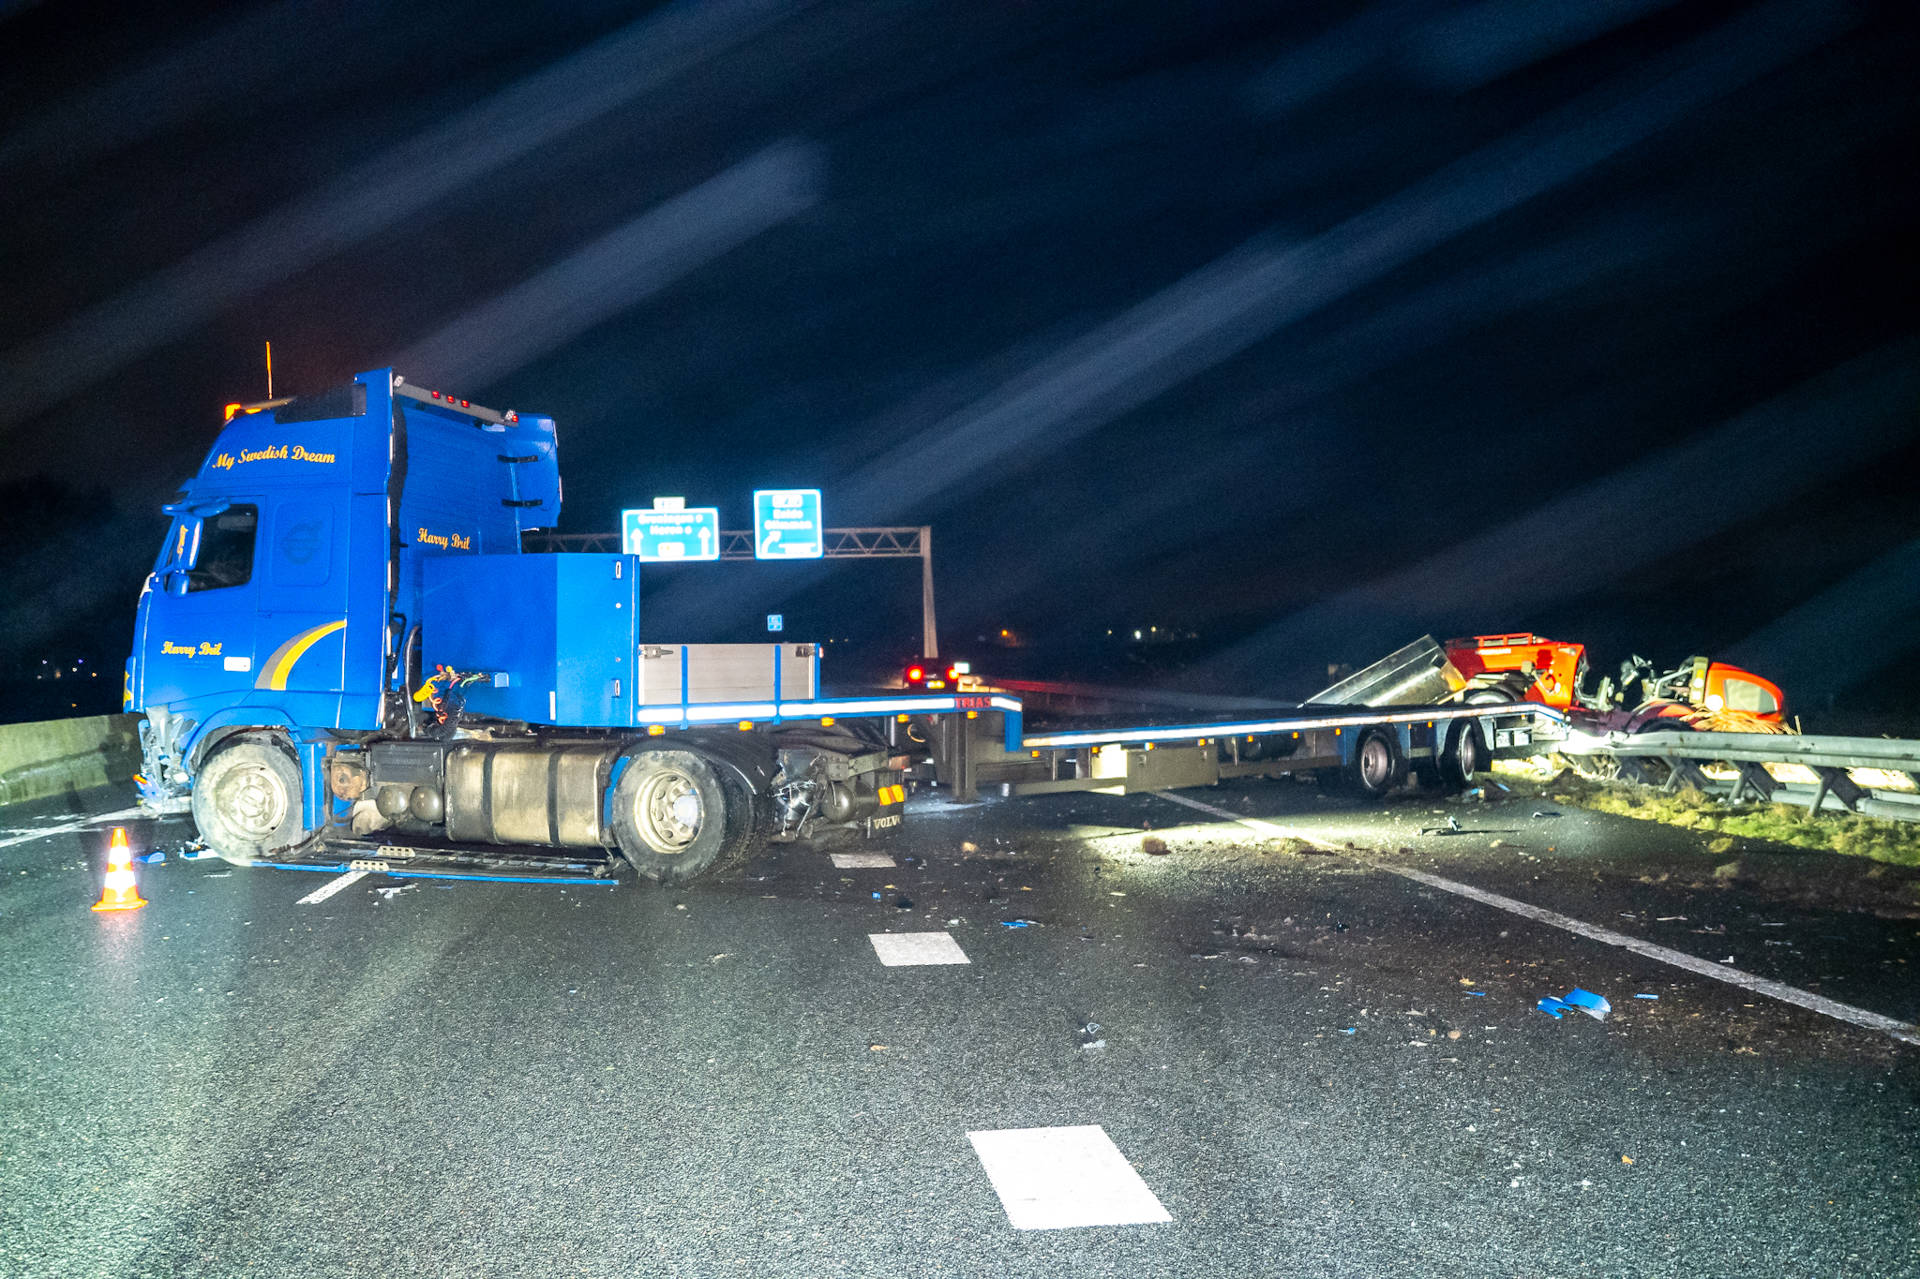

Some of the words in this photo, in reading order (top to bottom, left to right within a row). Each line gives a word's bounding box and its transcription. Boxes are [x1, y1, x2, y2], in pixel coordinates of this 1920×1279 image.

[212, 453, 235, 470] My
[238, 445, 288, 464] Swedish
[291, 445, 335, 463] Dream
[417, 528, 448, 550] Harry
[161, 641, 196, 658] Harry
[954, 697, 991, 709] TRIAS
